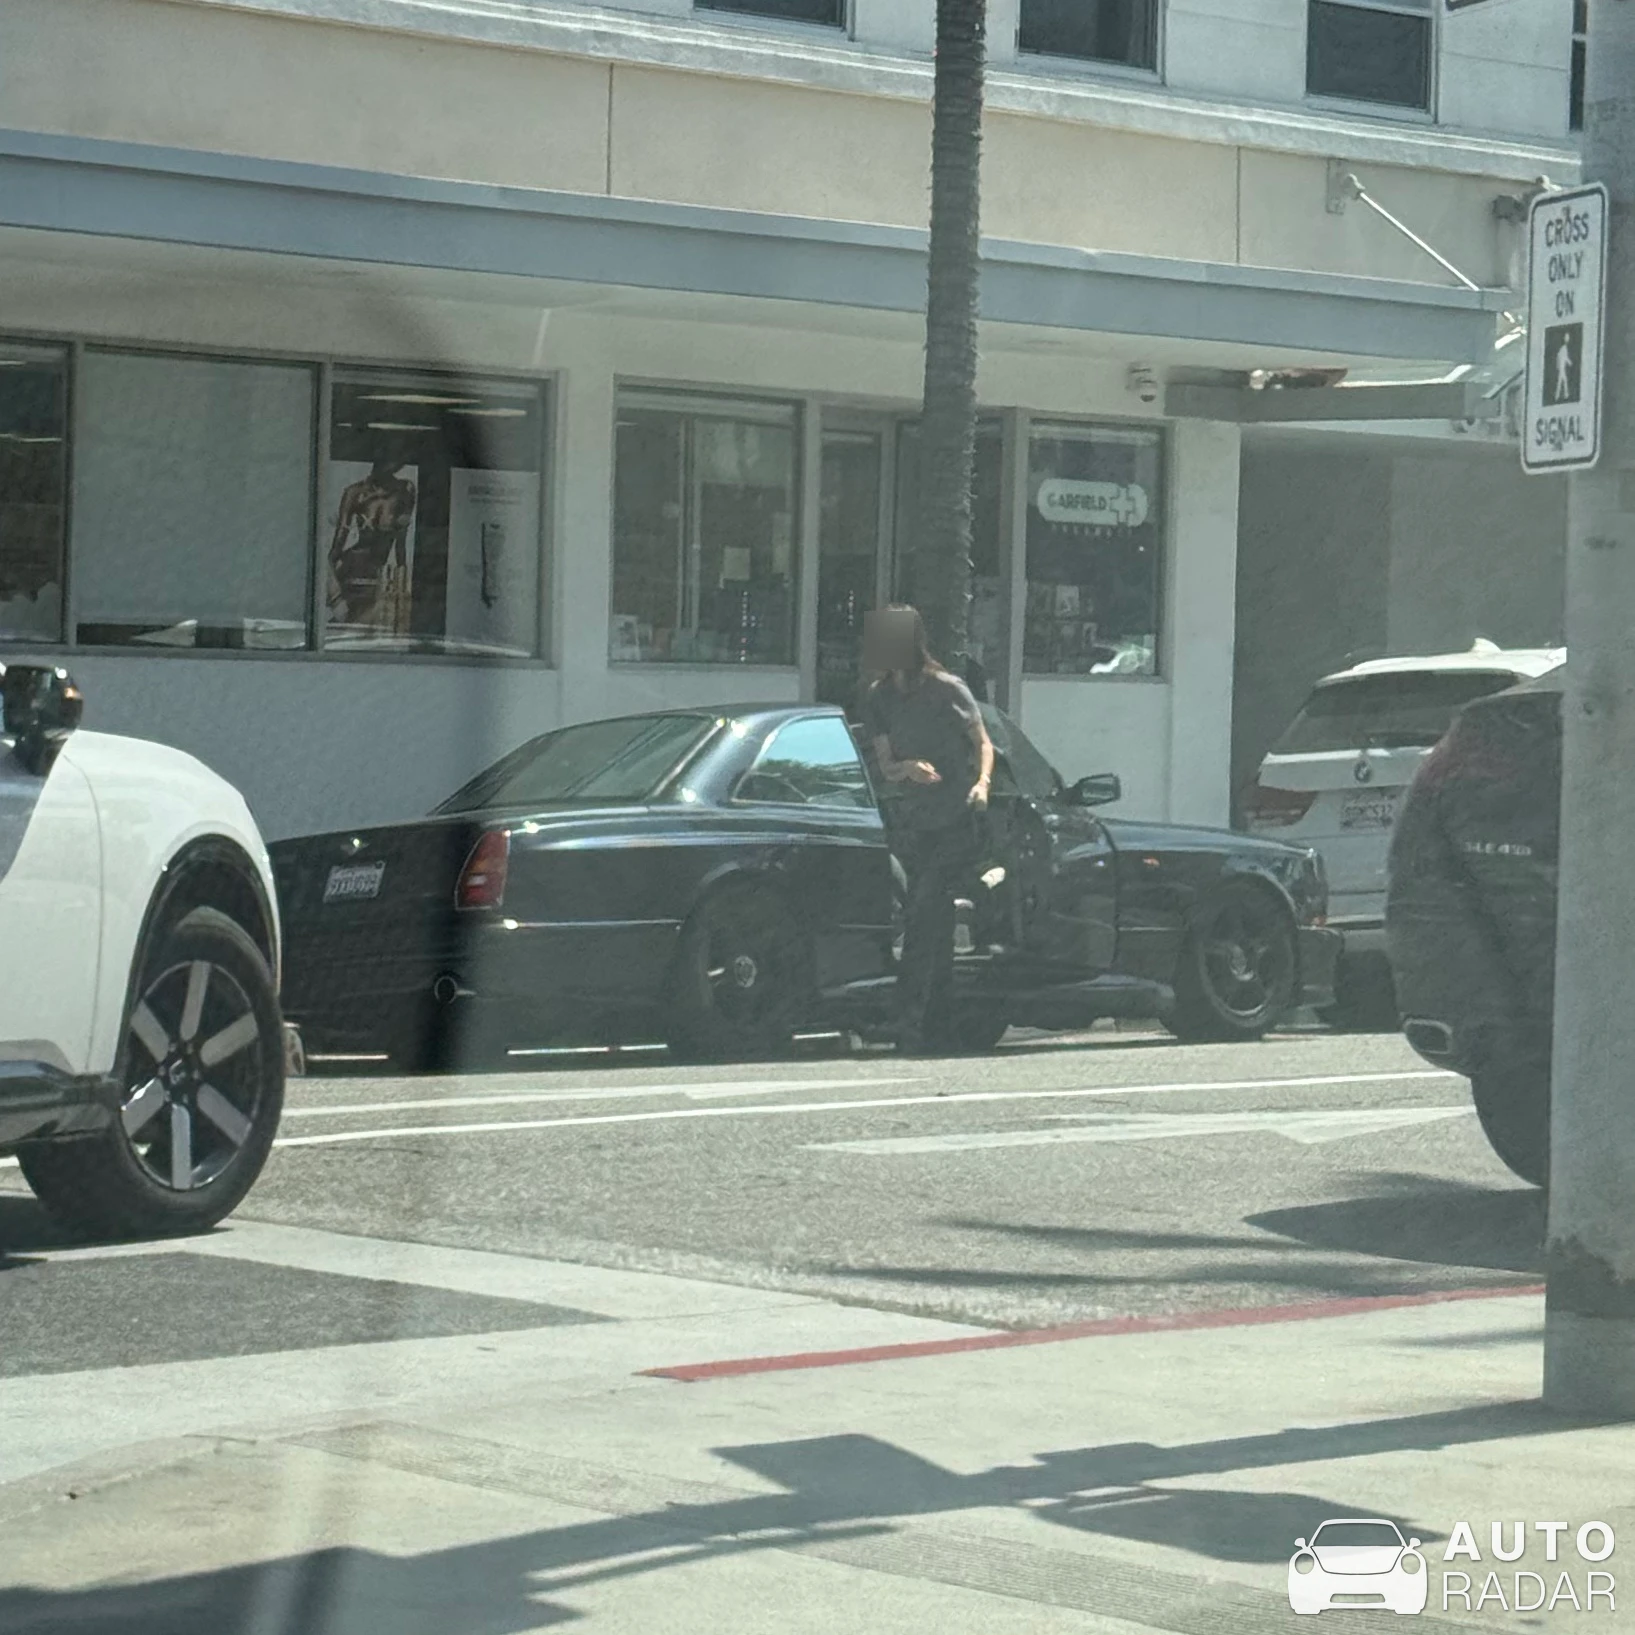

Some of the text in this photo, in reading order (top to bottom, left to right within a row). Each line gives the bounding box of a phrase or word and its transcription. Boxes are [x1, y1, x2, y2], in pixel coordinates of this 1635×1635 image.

[1545, 212, 1589, 247] CROSS
[1548, 251, 1584, 283] ONLY
[1555, 290, 1575, 318] ON
[1535, 415, 1584, 446] SIGNAL
